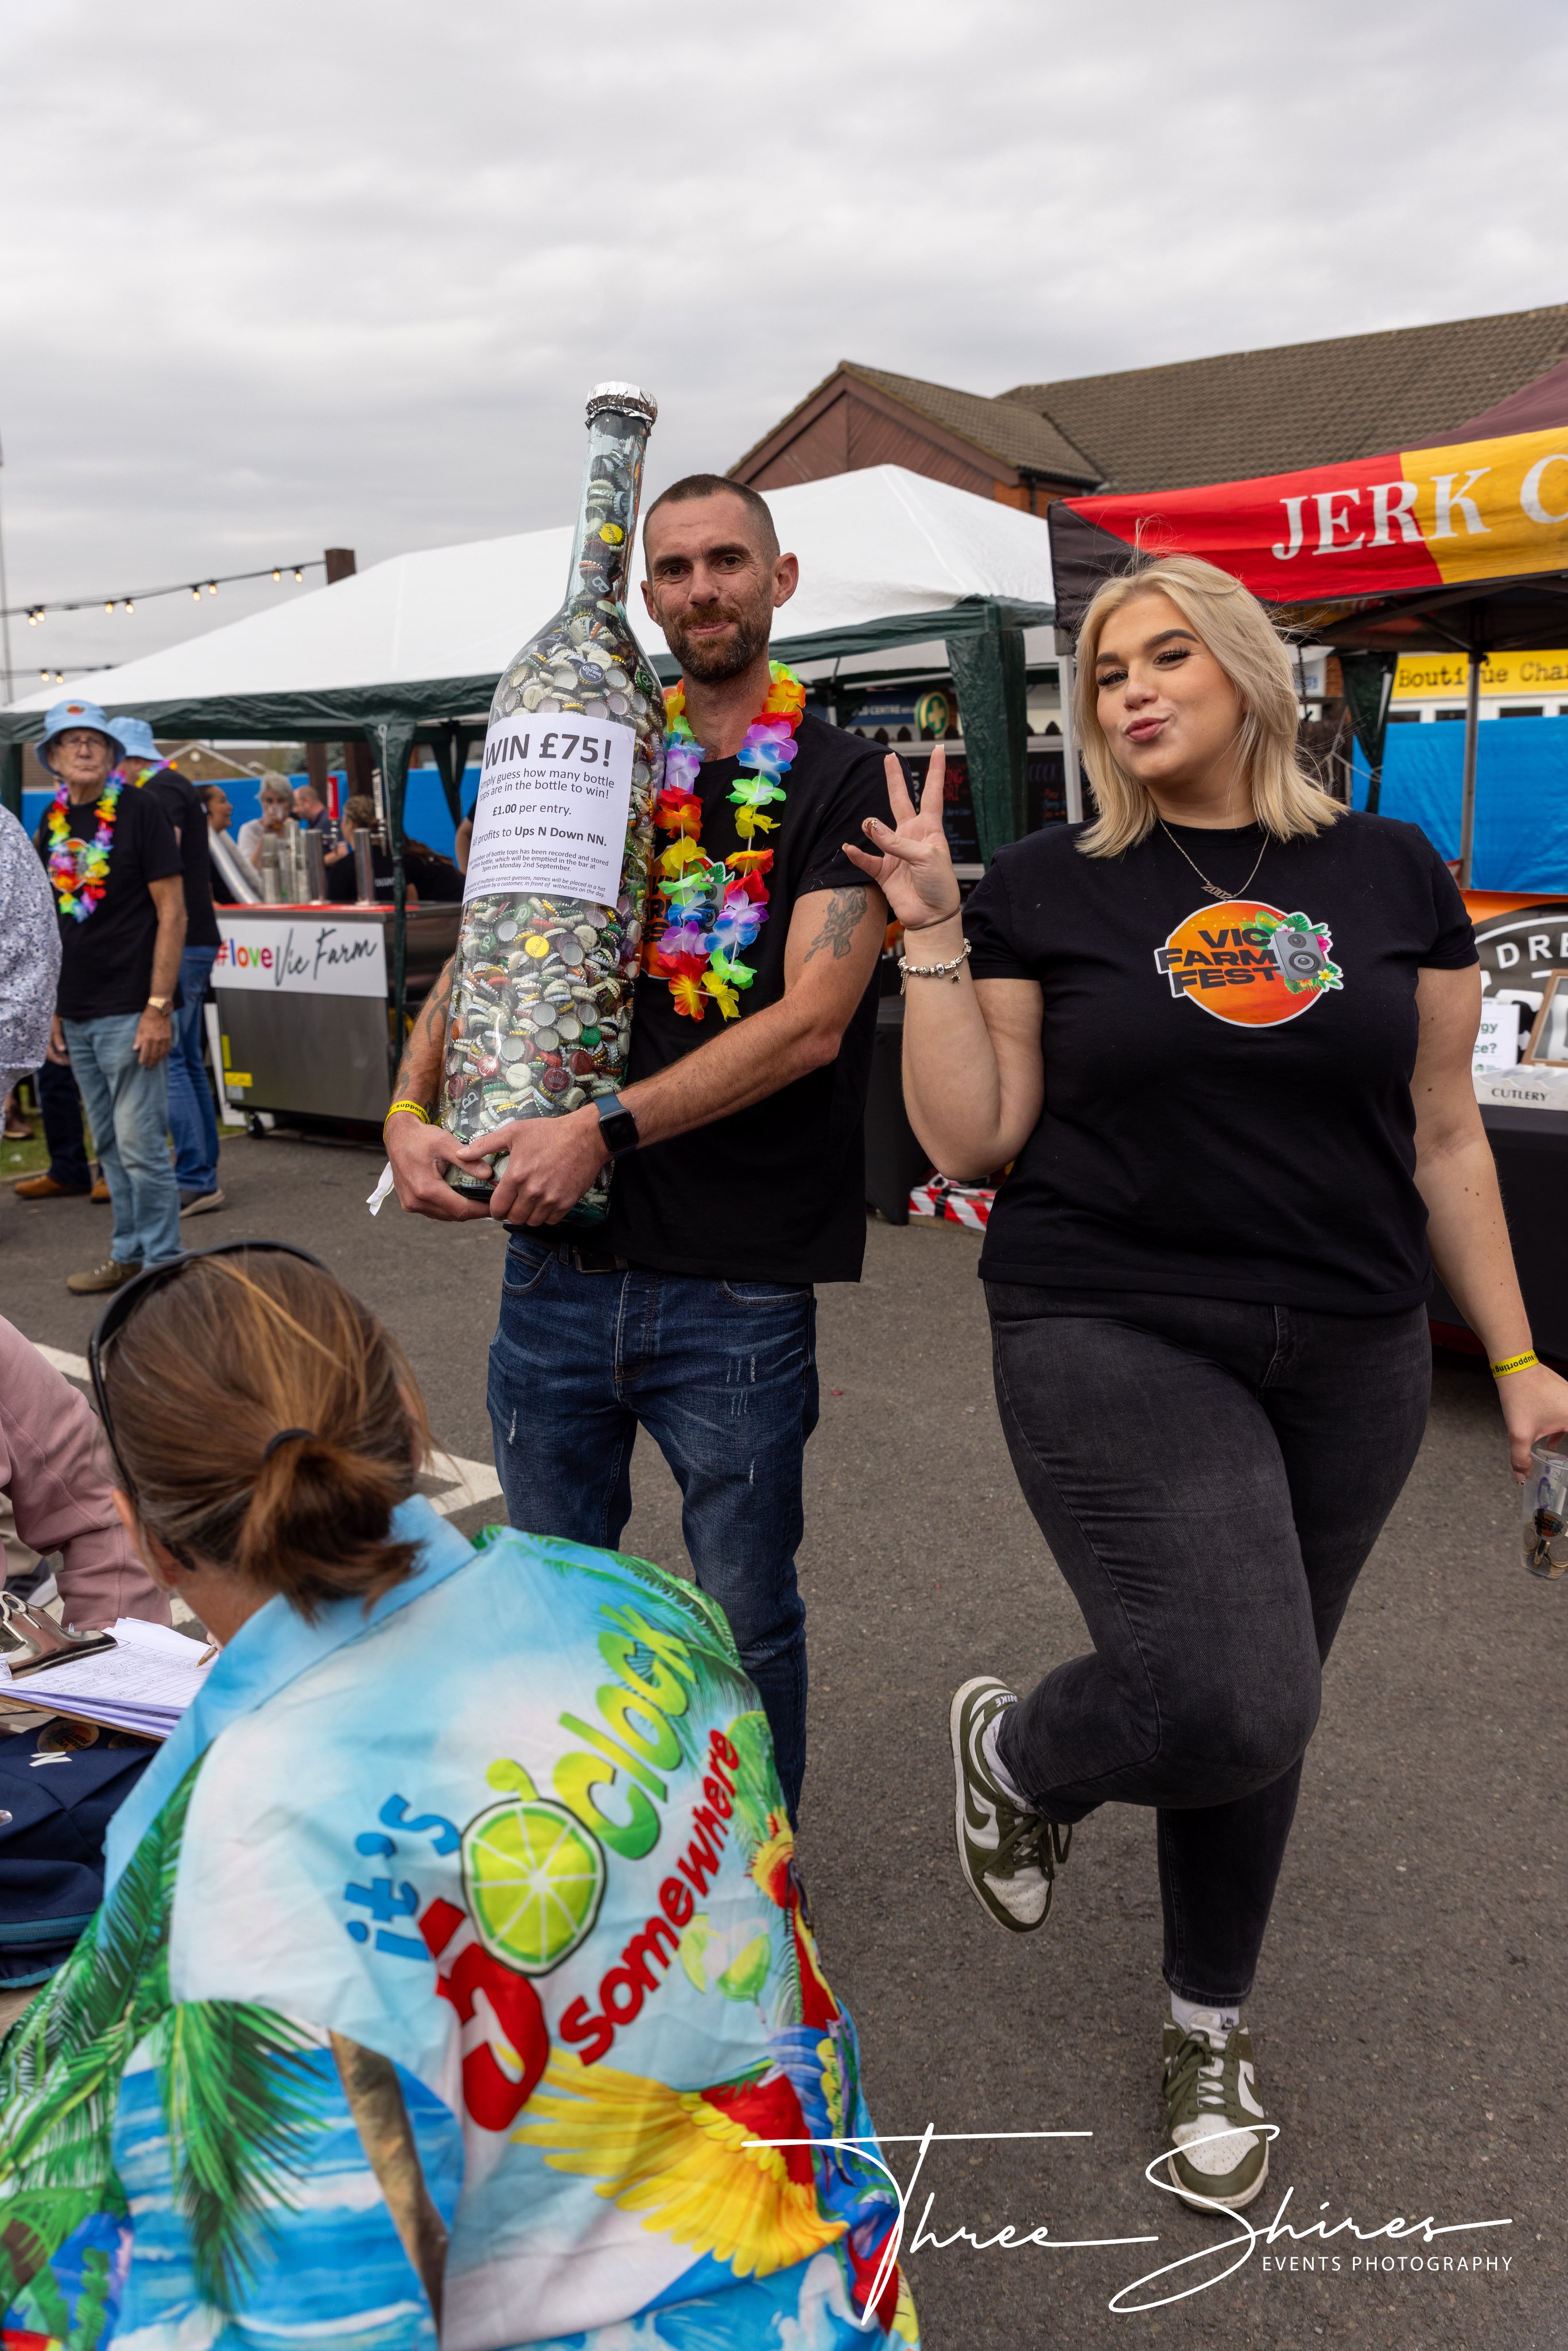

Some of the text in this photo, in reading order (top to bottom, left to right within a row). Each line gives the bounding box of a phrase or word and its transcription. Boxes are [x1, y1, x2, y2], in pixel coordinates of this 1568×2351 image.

[1271, 466, 1492, 561] JERK
[582, 665, 601, 677] Corona
[1399, 660, 1568, 688] Boutiue Cha
[486, 732, 612, 770] WIN £75!
[497, 771, 521, 784] guess
[523, 768, 546, 778] how
[549, 770, 580, 782] many
[584, 772, 615, 788] bottle
[479, 779, 609, 802] tops are in the bottle to win!
[492, 804, 572, 816] £1.00 per entry.
[478, 830, 499, 846] profits
[502, 828, 511, 837] to
[515, 827, 534, 837] Ups
[538, 827, 547, 836] N
[550, 827, 584, 841] Down
[587, 833, 607, 847] NN.
[473, 855, 486, 864] number
[549, 851, 576, 859] recorded
[591, 857, 609, 866] stored
[536, 862, 571, 871] September.
[1198, 928, 1271, 949] VIC
[314, 928, 377, 981] Farm
[1157, 948, 1278, 972] FARM
[1172, 966, 1281, 996] FEST
[1491, 1088, 1548, 1102] CUTLERY
[396, 1103, 429, 1124] supporting
[1495, 1355, 1535, 1372] supporting
[995, 1695, 1018, 1708] NIKE
[559, 1729, 740, 2066] somewhere
